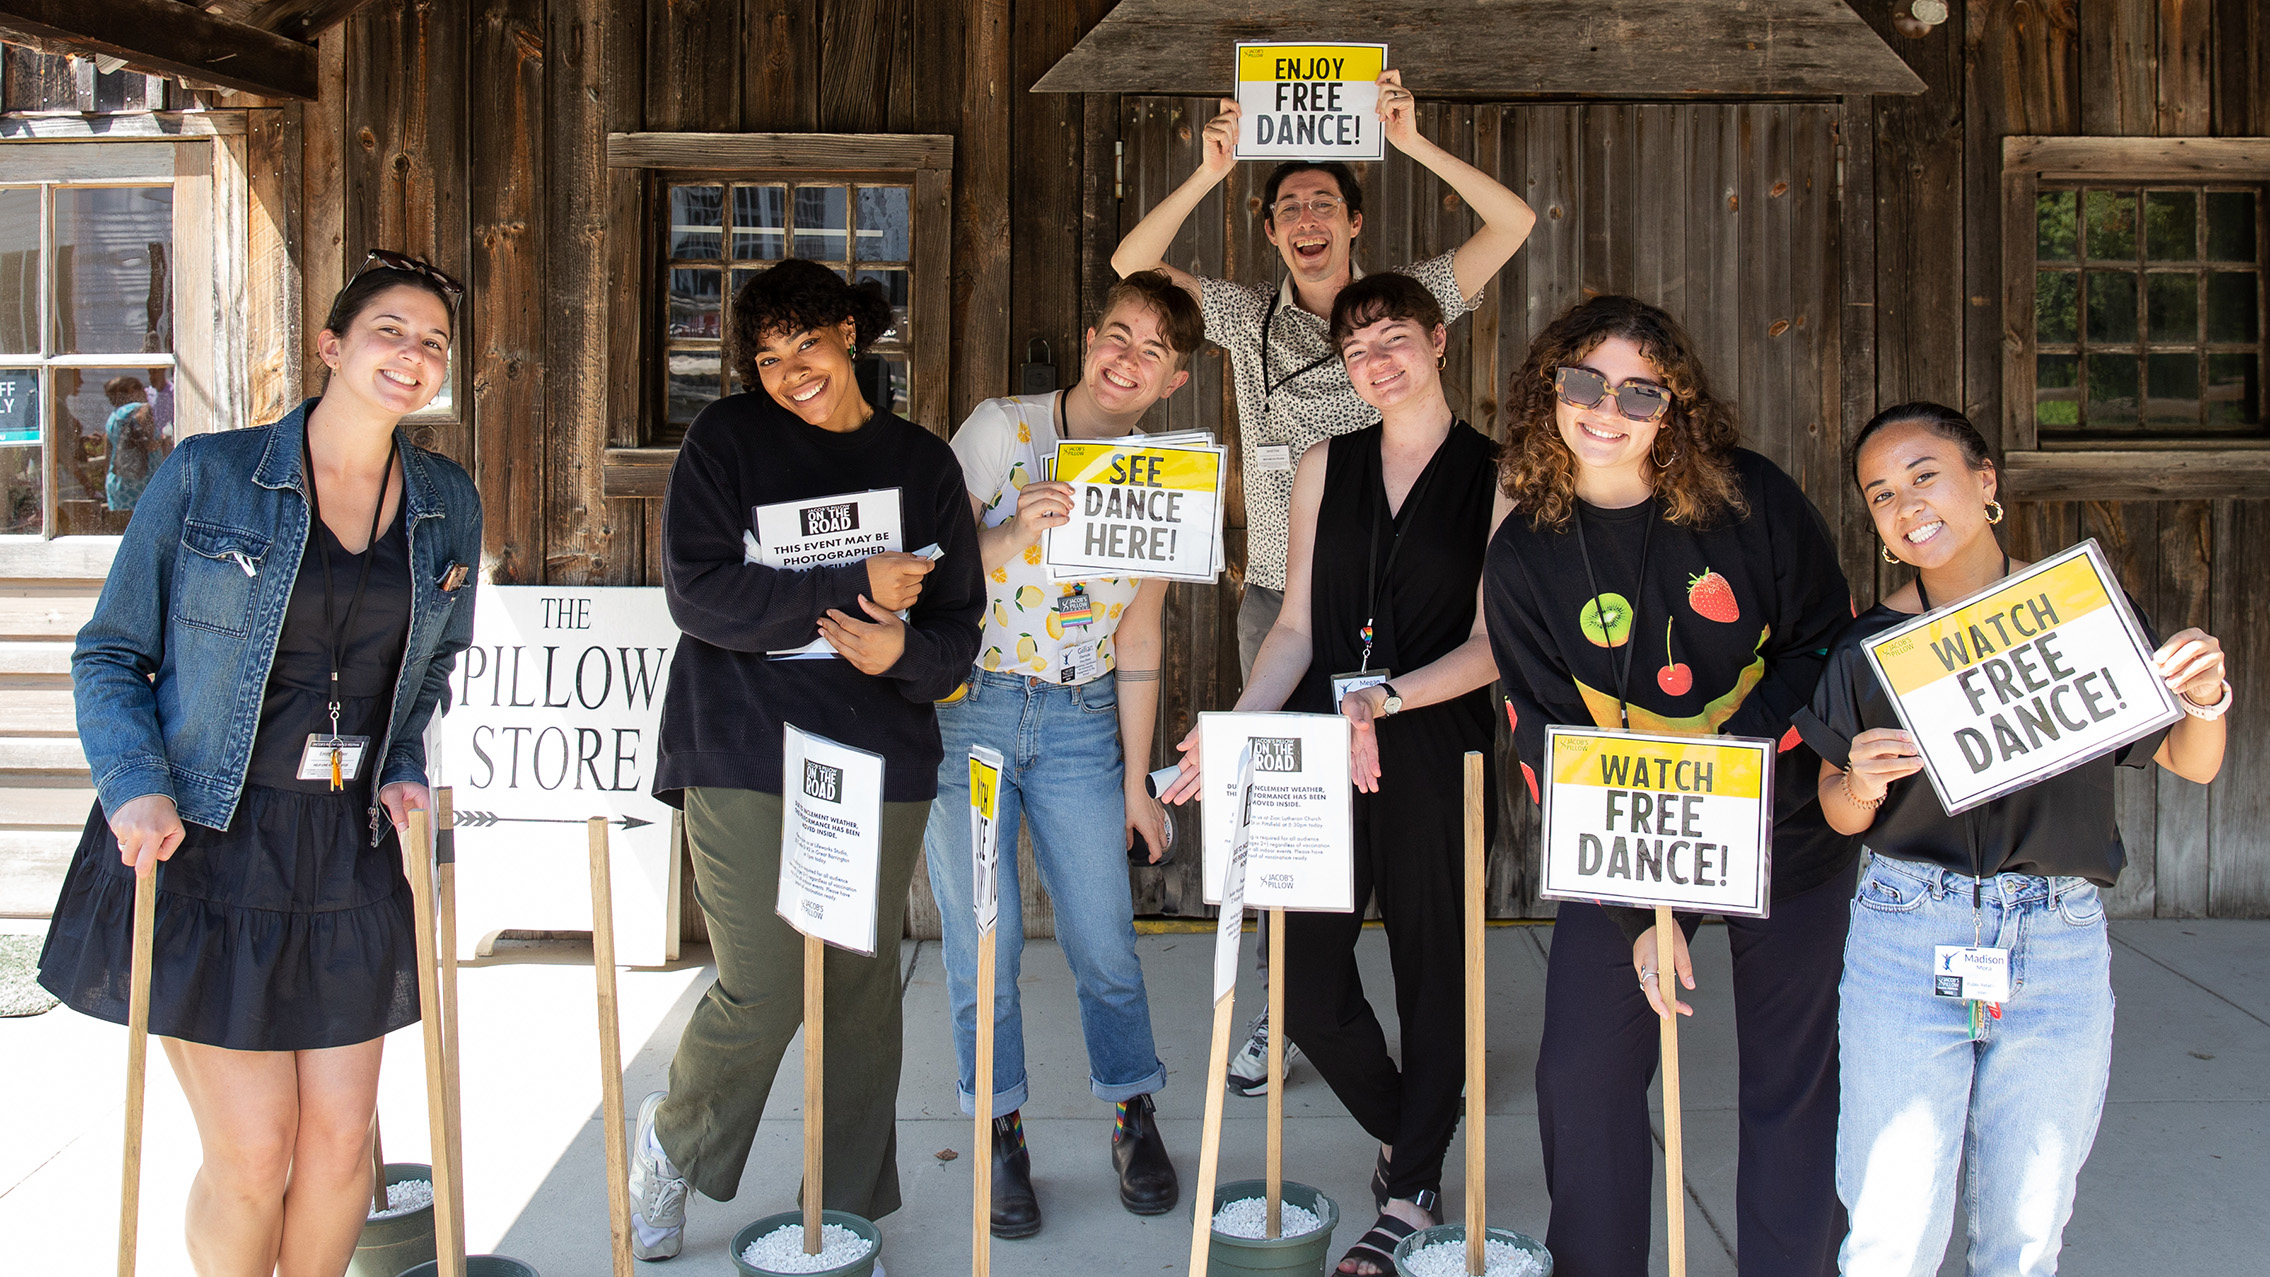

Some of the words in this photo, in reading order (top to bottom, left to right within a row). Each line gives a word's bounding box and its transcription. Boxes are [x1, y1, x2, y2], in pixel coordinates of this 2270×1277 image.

[1276, 58, 1344, 79] ENJOY
[1276, 83, 1343, 111] FREE
[1257, 115, 1361, 145] DANCE!
[1109, 454, 1164, 487] SEE
[808, 511, 824, 520] ON
[830, 508, 850, 518] THE
[1085, 486, 1183, 523] DANCE
[809, 517, 851, 534] ROAD
[774, 545, 801, 555] THIS
[804, 539, 841, 550] EVENT
[845, 535, 871, 545] MAY
[875, 532, 889, 541] BE
[1085, 523, 1176, 561] HERE!
[784, 546, 886, 566] PHOTOGRAPHED
[541, 598, 591, 629] THE
[1888, 638, 1912, 652] JACOB'S
[1930, 593, 2060, 672] WATCH
[1890, 643, 1914, 657] PILLOW
[459, 646, 668, 711] PILLOW
[1957, 631, 2076, 716] FREE
[1953, 667, 2128, 774] DANCE!
[470, 725, 641, 791] STORE
[1255, 743, 1269, 754] ON
[1274, 744, 1294, 755] THE
[1255, 754, 1294, 771] ROAD
[1601, 754, 1713, 792] WATCH
[807, 766, 816, 780] ON
[820, 770, 836, 785] THE
[806, 777, 836, 800] ROAD
[831, 817, 858, 829] WEATHER,
[1606, 790, 1704, 838] FREE
[817, 829, 837, 839] INSIDE.
[1578, 833, 1728, 887] DANCE!
[1965, 954, 2004, 964] Madison
